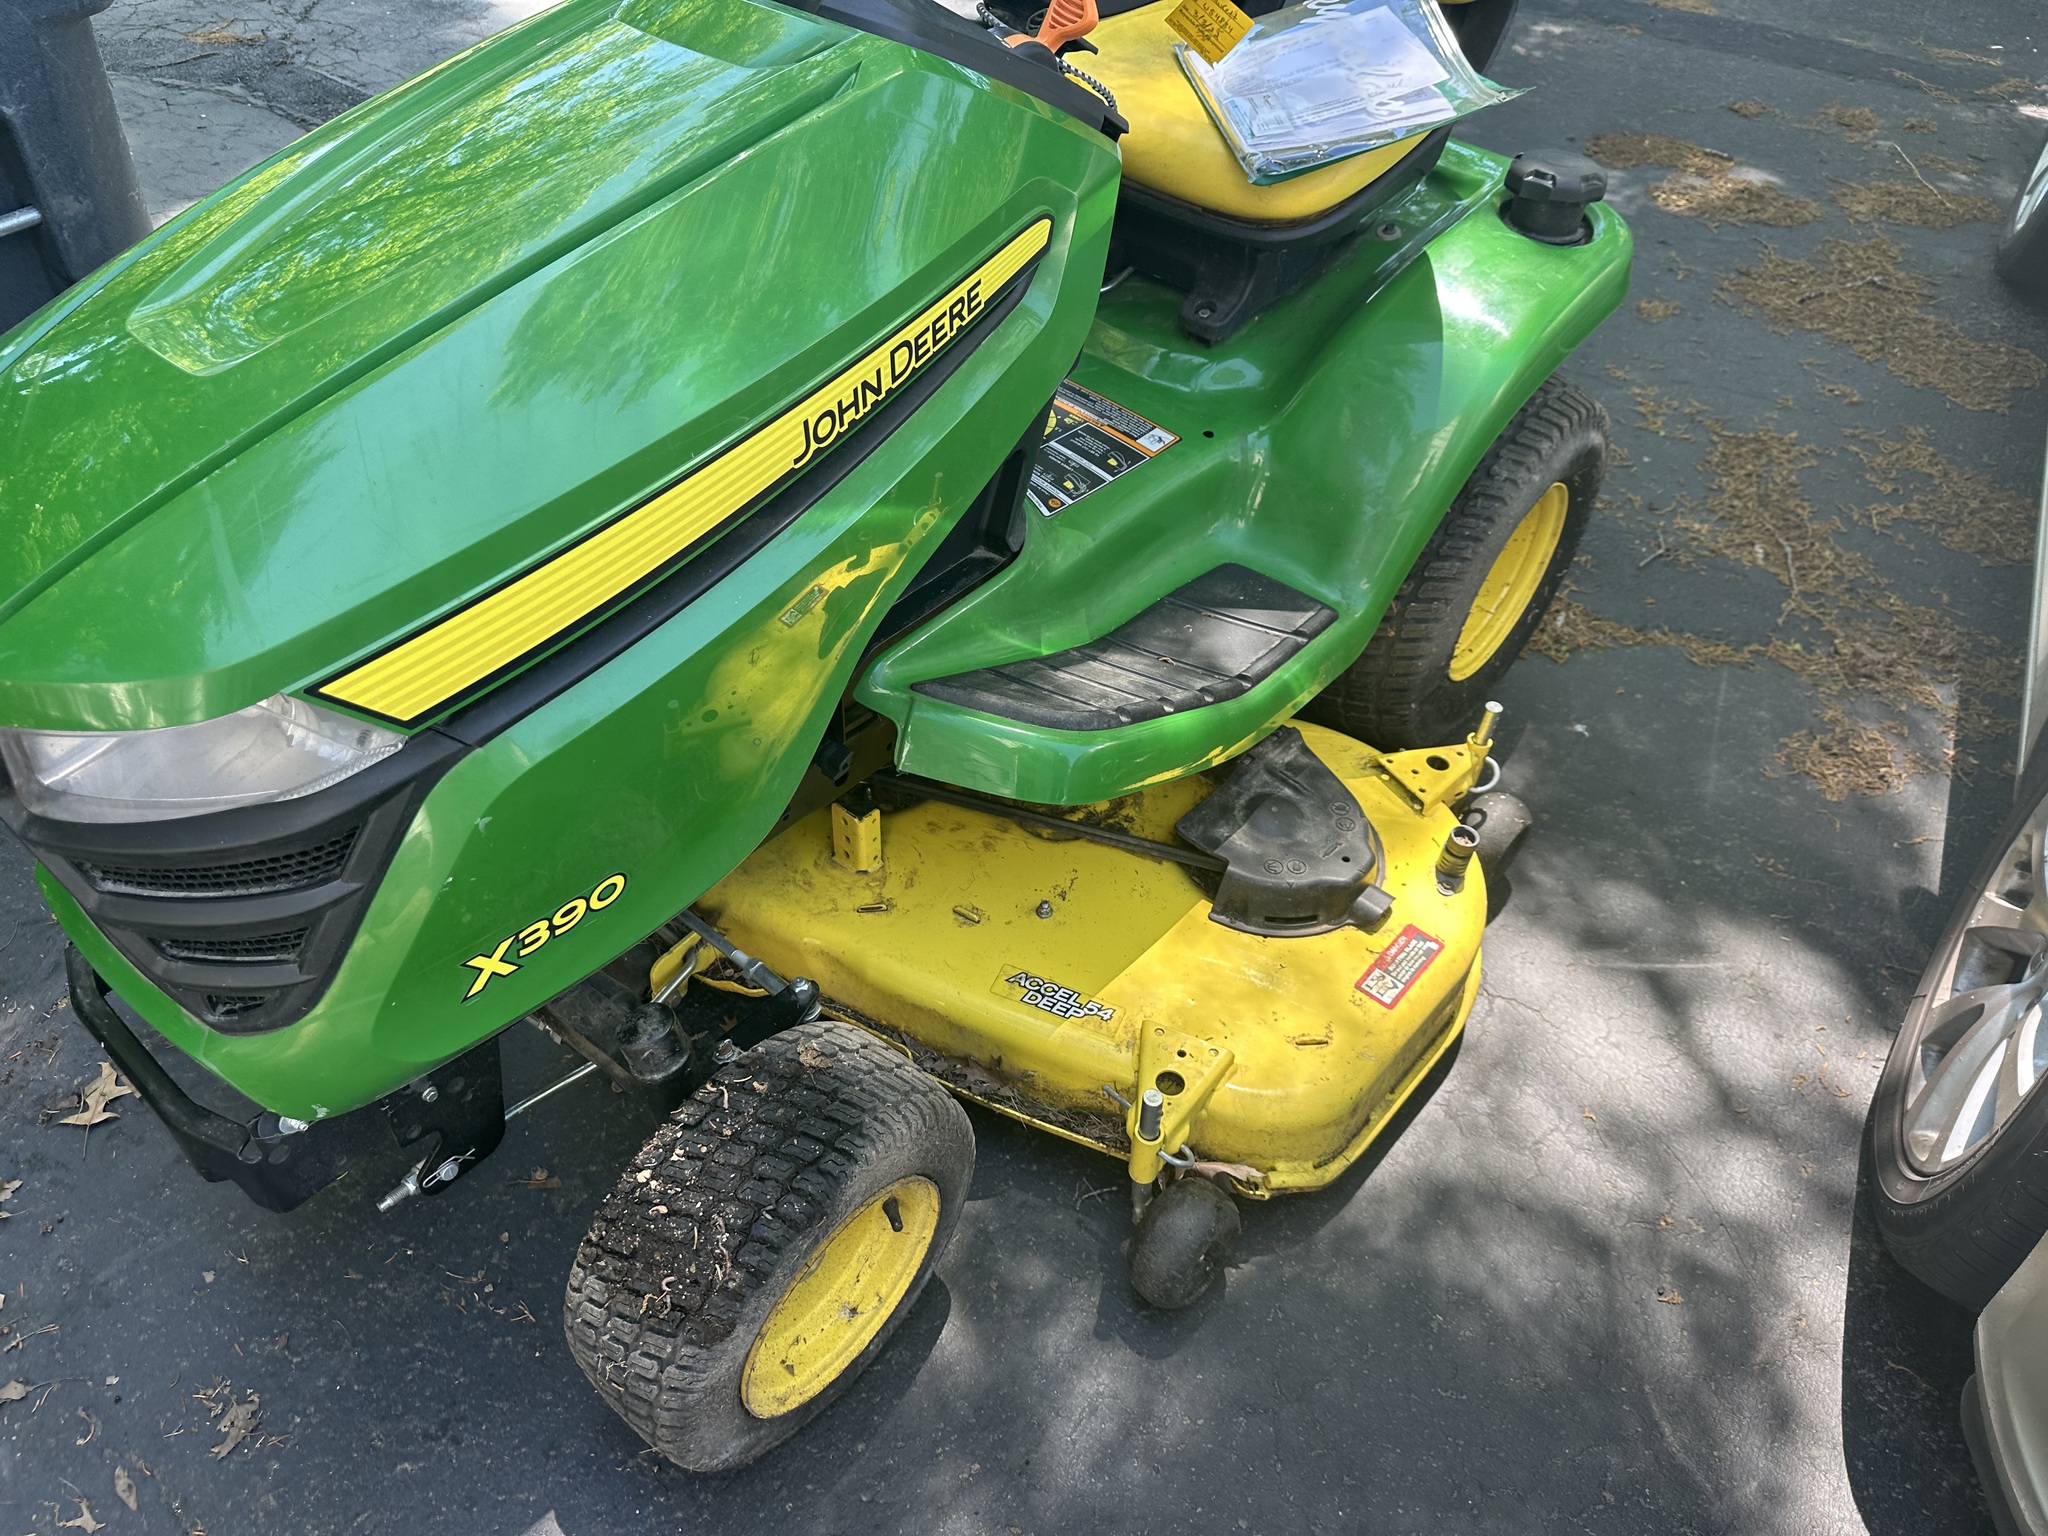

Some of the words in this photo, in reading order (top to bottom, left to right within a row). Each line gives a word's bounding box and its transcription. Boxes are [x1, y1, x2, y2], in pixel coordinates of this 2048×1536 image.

[792, 367, 884, 466] JOHN
[889, 278, 984, 386] DEERE
[459, 872, 628, 1004] X390
[1004, 972, 1081, 1008] ACCEL
[1083, 1000, 1116, 1022] 54
[1020, 990, 1086, 1019] DEEP
